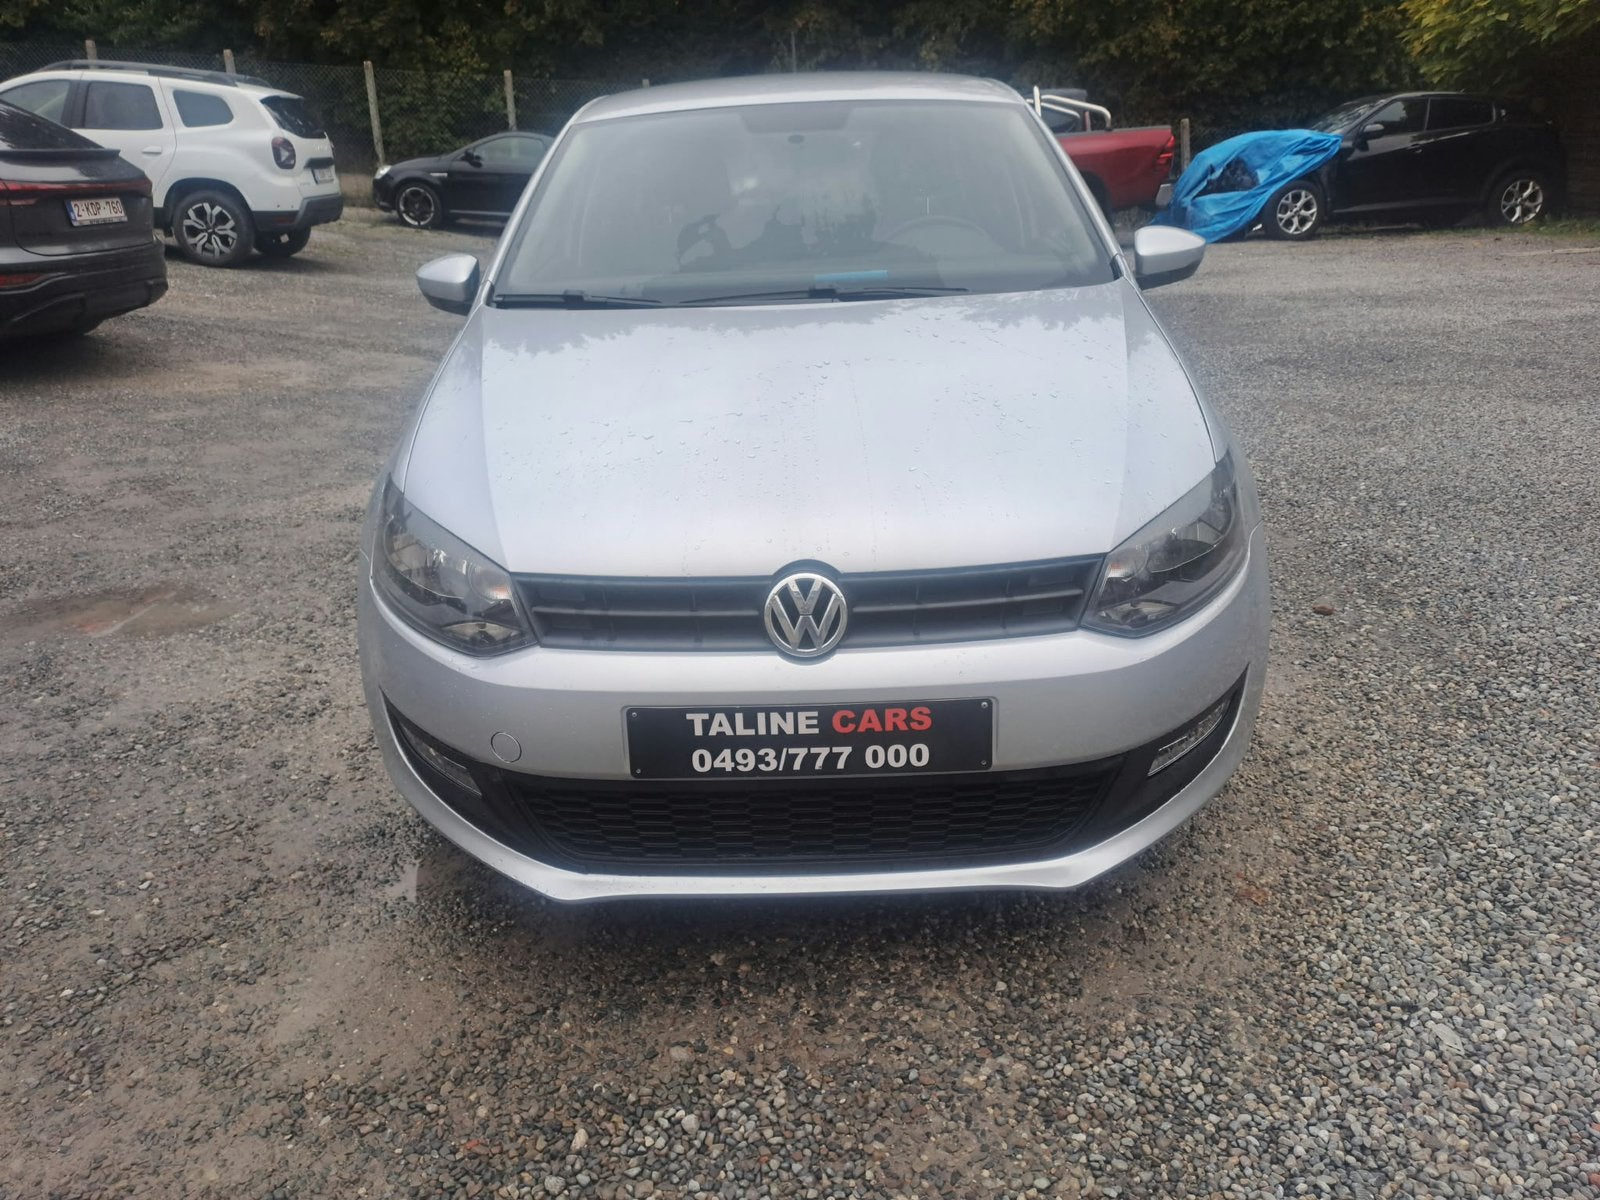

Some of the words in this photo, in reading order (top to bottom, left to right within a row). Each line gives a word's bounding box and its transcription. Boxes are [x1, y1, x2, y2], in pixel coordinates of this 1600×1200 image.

[686, 711, 819, 736] TALINE
[832, 707, 933, 733] CARS
[691, 747, 852, 773] 0493/777
[864, 743, 930, 769] 000
